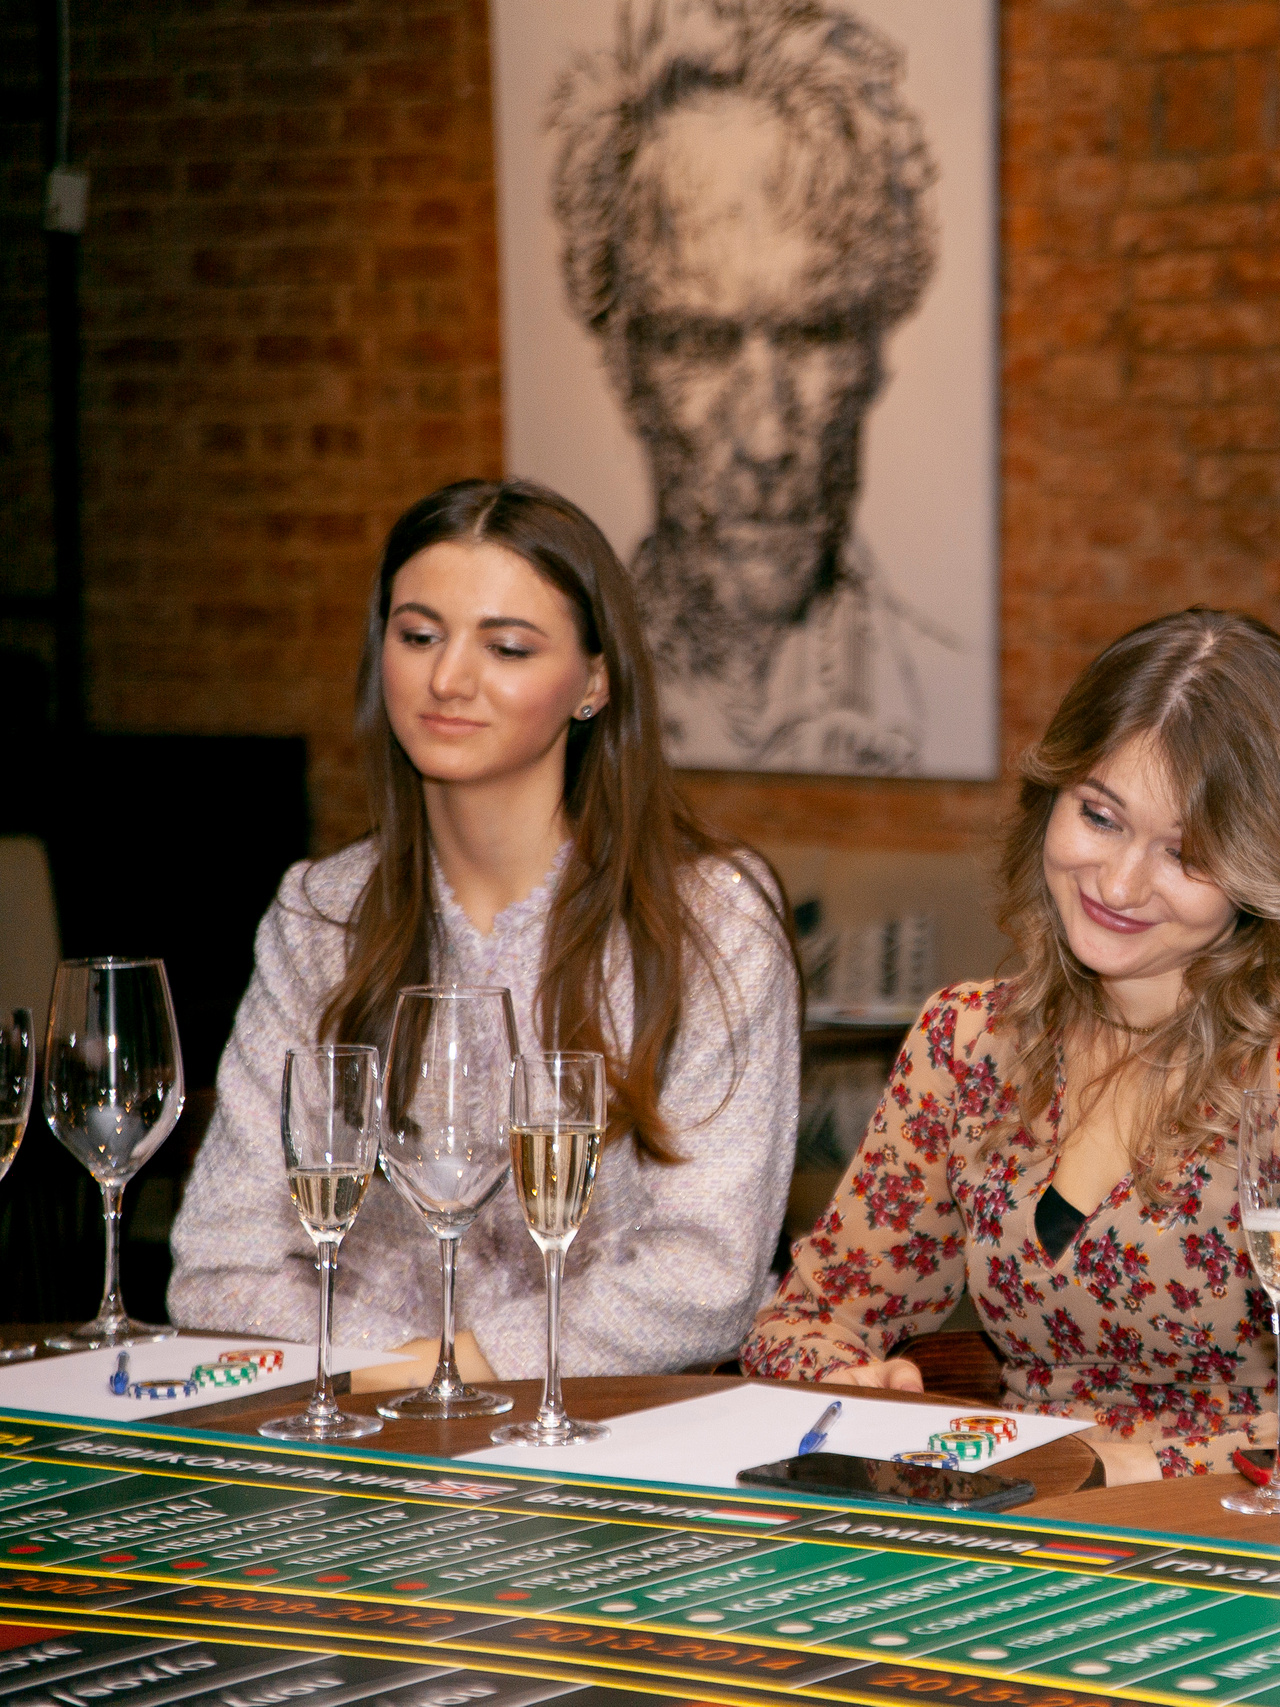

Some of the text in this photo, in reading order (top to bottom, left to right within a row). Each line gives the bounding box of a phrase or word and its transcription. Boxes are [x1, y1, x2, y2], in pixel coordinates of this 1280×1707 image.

[56, 1442, 429, 1490] ВЕЛИКОБРИТАНИЯ
[28, 1499, 213, 1543] ГАРНАЧА/
[523, 1493, 714, 1519] ВЕНГРИЯ
[73, 1511, 229, 1547] ГРЕНАШ
[142, 1509, 327, 1554] НЕББИОЛО
[212, 1509, 410, 1561] ПИНО НУАР
[285, 1513, 500, 1567] ТЕМПРАНИЛЬО
[812, 1522, 1043, 1552] АРМЕНИЯ
[358, 1536, 507, 1575] МЕНСИЯ
[438, 1541, 593, 1582] ЛАГРЕЙН
[510, 1535, 715, 1590] ПРИМИТИВО/
[556, 1540, 758, 1593] ЗИНФАНДЕЛЬ
[645, 1566, 776, 1603] АРНЕИС
[722, 1573, 866, 1613] КОРТЕЗЕ
[811, 1565, 1013, 1624] ВЕРМЕНТИНО
[909, 1576, 1104, 1636] СОВИНЬОН БЛАН
[176, 1594, 455, 1629] 2008-2012
[1004, 1587, 1192, 1649] ГЕВЮРЦТРАМИНЕР
[510, 1627, 807, 1671] 2013-2014
[1102, 1630, 1217, 1665] ВИУРА
